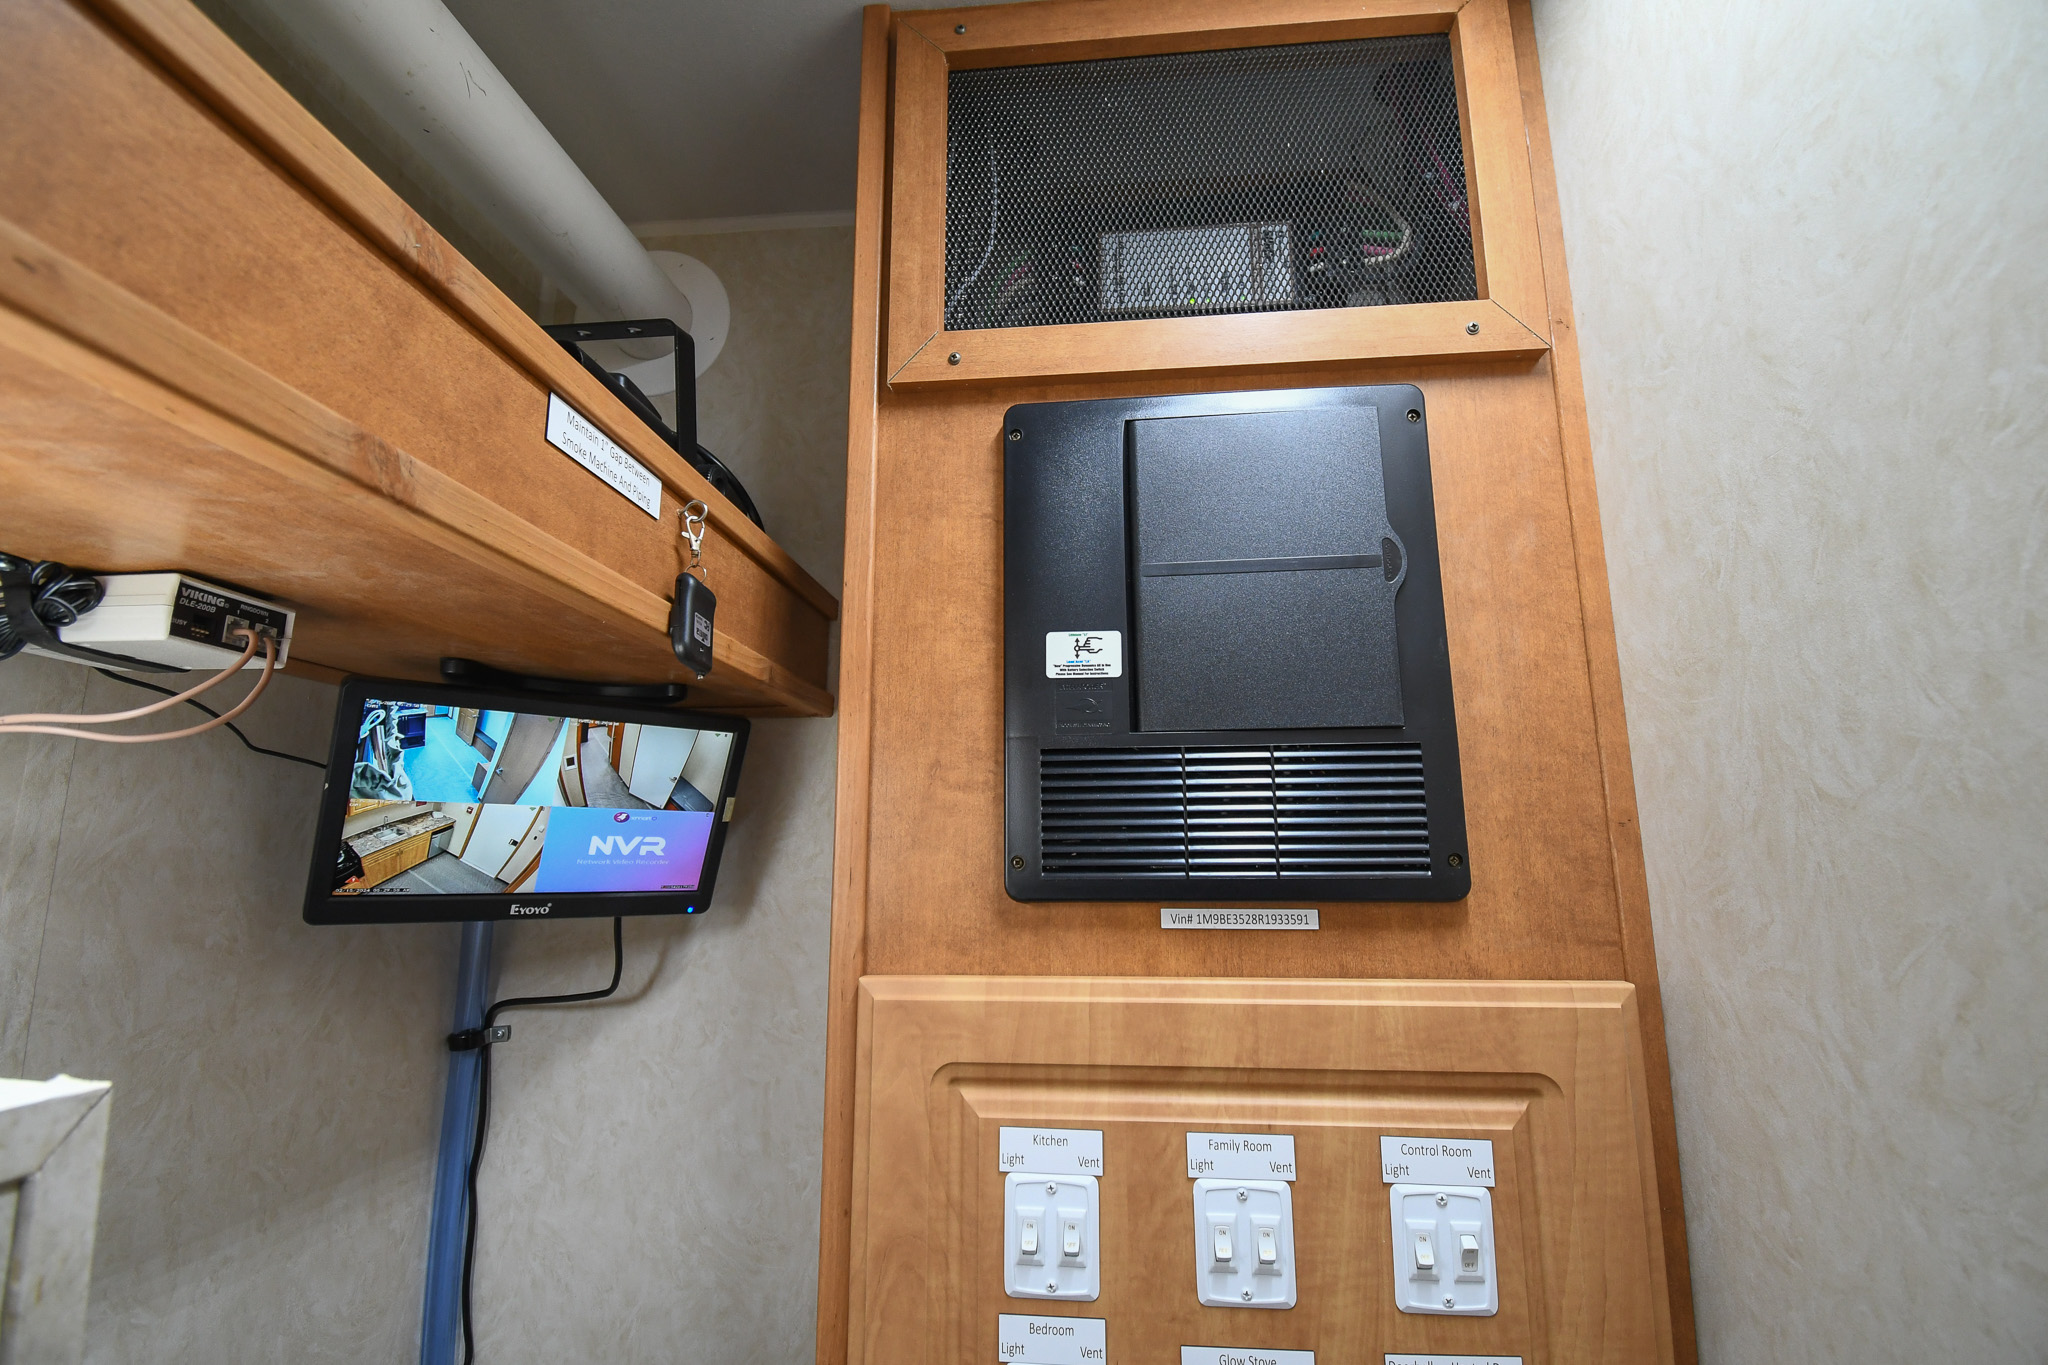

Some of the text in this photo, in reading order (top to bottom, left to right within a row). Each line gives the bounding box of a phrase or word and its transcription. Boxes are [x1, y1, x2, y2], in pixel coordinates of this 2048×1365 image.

[567, 411, 599, 447] Maintain
[610, 446, 623, 466] Gap
[624, 457, 650, 487] Between
[562, 432, 651, 510] Smoke Machine And Piping
[180, 597, 217, 613] DLE-200B
[182, 587, 226, 608] VIKING
[588, 835, 666, 856] NVR
[1170, 913, 1310, 926] Vin# 1M9BE3528R1933591
[1033, 1134, 1069, 1147] Kitchen
[1208, 1138, 1272, 1154] Family Room
[1400, 1143, 1472, 1157] Control Room
[1001, 1153, 1100, 1168] Light Vent
[1190, 1159, 1293, 1173] Light Vent
[1385, 1163, 1491, 1179] Light Vent
[1029, 1323, 1075, 1336] Bedroom
[1001, 1342, 1103, 1359] Light Vent
[1219, 1354, 1277, 1365] Glow Stove
